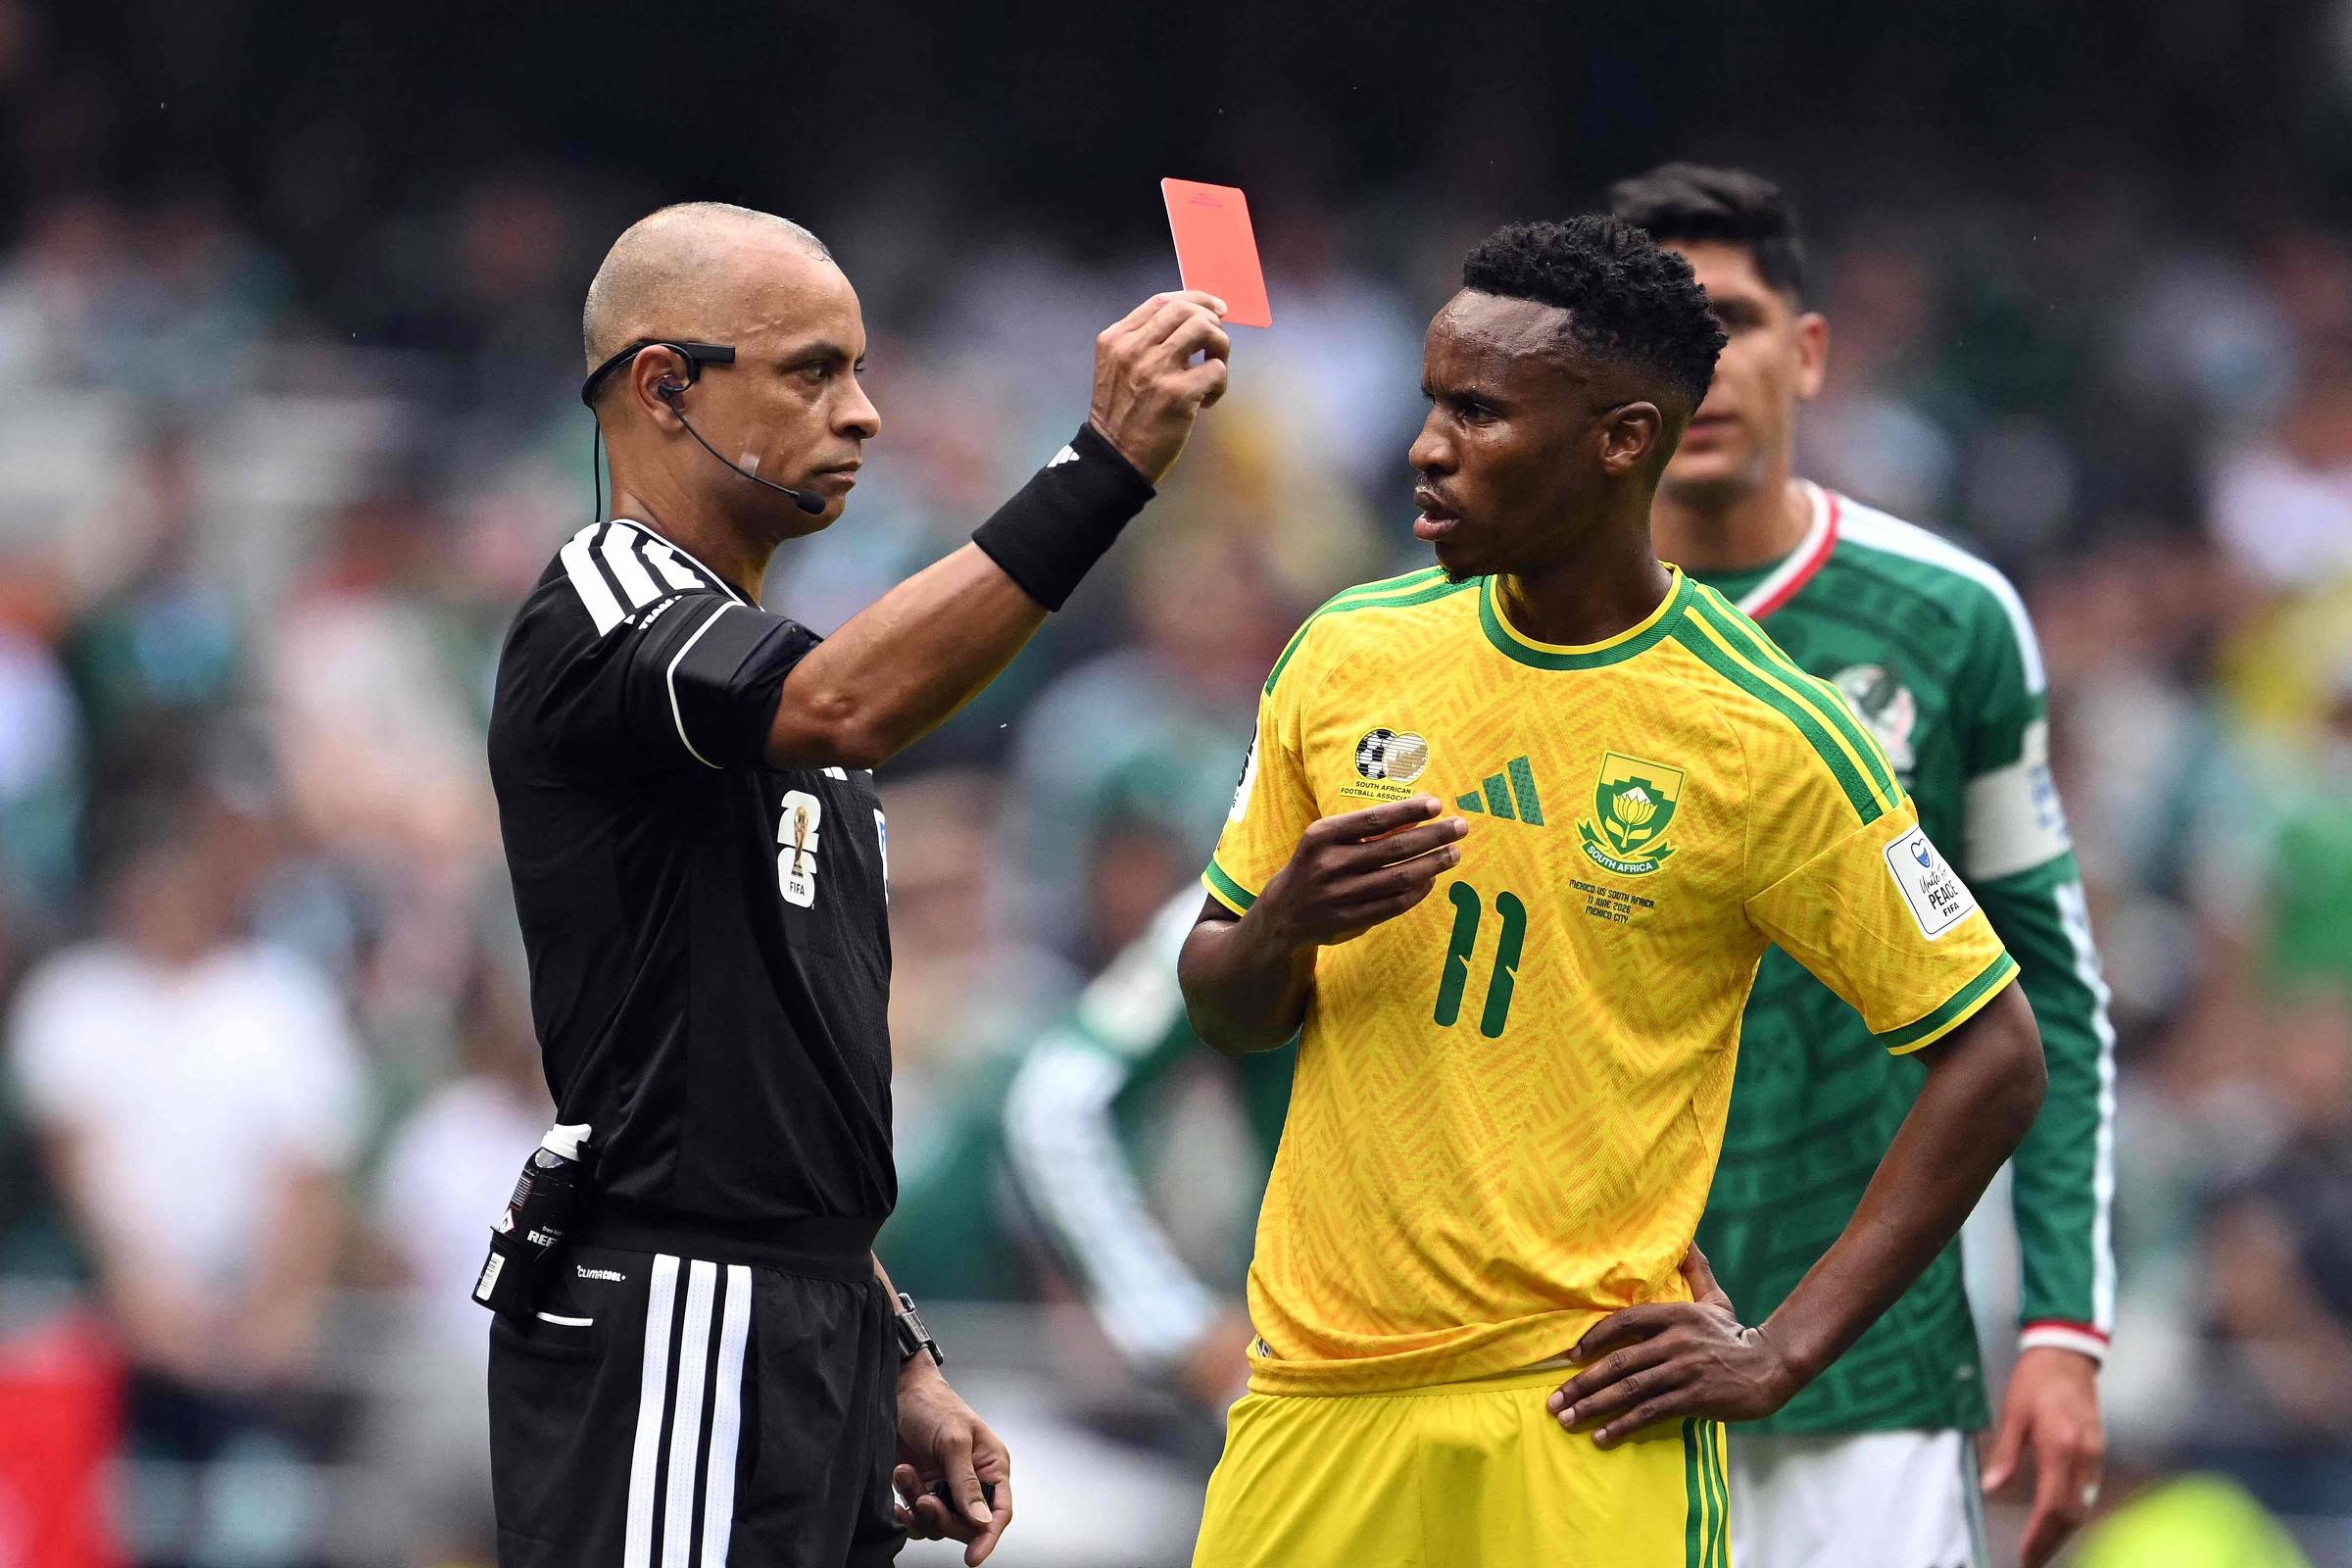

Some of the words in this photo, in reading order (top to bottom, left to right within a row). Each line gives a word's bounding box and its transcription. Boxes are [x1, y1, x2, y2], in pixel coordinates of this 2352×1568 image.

[1341, 788, 1374, 797] FOOTBALL
[1376, 792, 1411, 801] ASSOCIA
[1355, 781, 1380, 790] SOUTH
[1381, 785, 1412, 795] AFRICAN
[1588, 846, 1617, 870] SOUTH
[1617, 862, 1652, 872] AFRICA
[789, 881, 806, 896] FIFA
[1569, 879, 1595, 893] MEXICO
[1608, 890, 1630, 903] SOUTH
[1631, 896, 1654, 908] AFRICA
[1929, 880, 1958, 909] PEACE
[1588, 895, 1593, 906] 11
[1594, 897, 1612, 908] JUNE
[1613, 902, 1632, 914] 2026
[1943, 903, 1959, 916] FIFA
[1586, 906, 1612, 919] MEXICO
[1613, 912, 1629, 924] CITY
[1434, 881, 1527, 1038] 11
